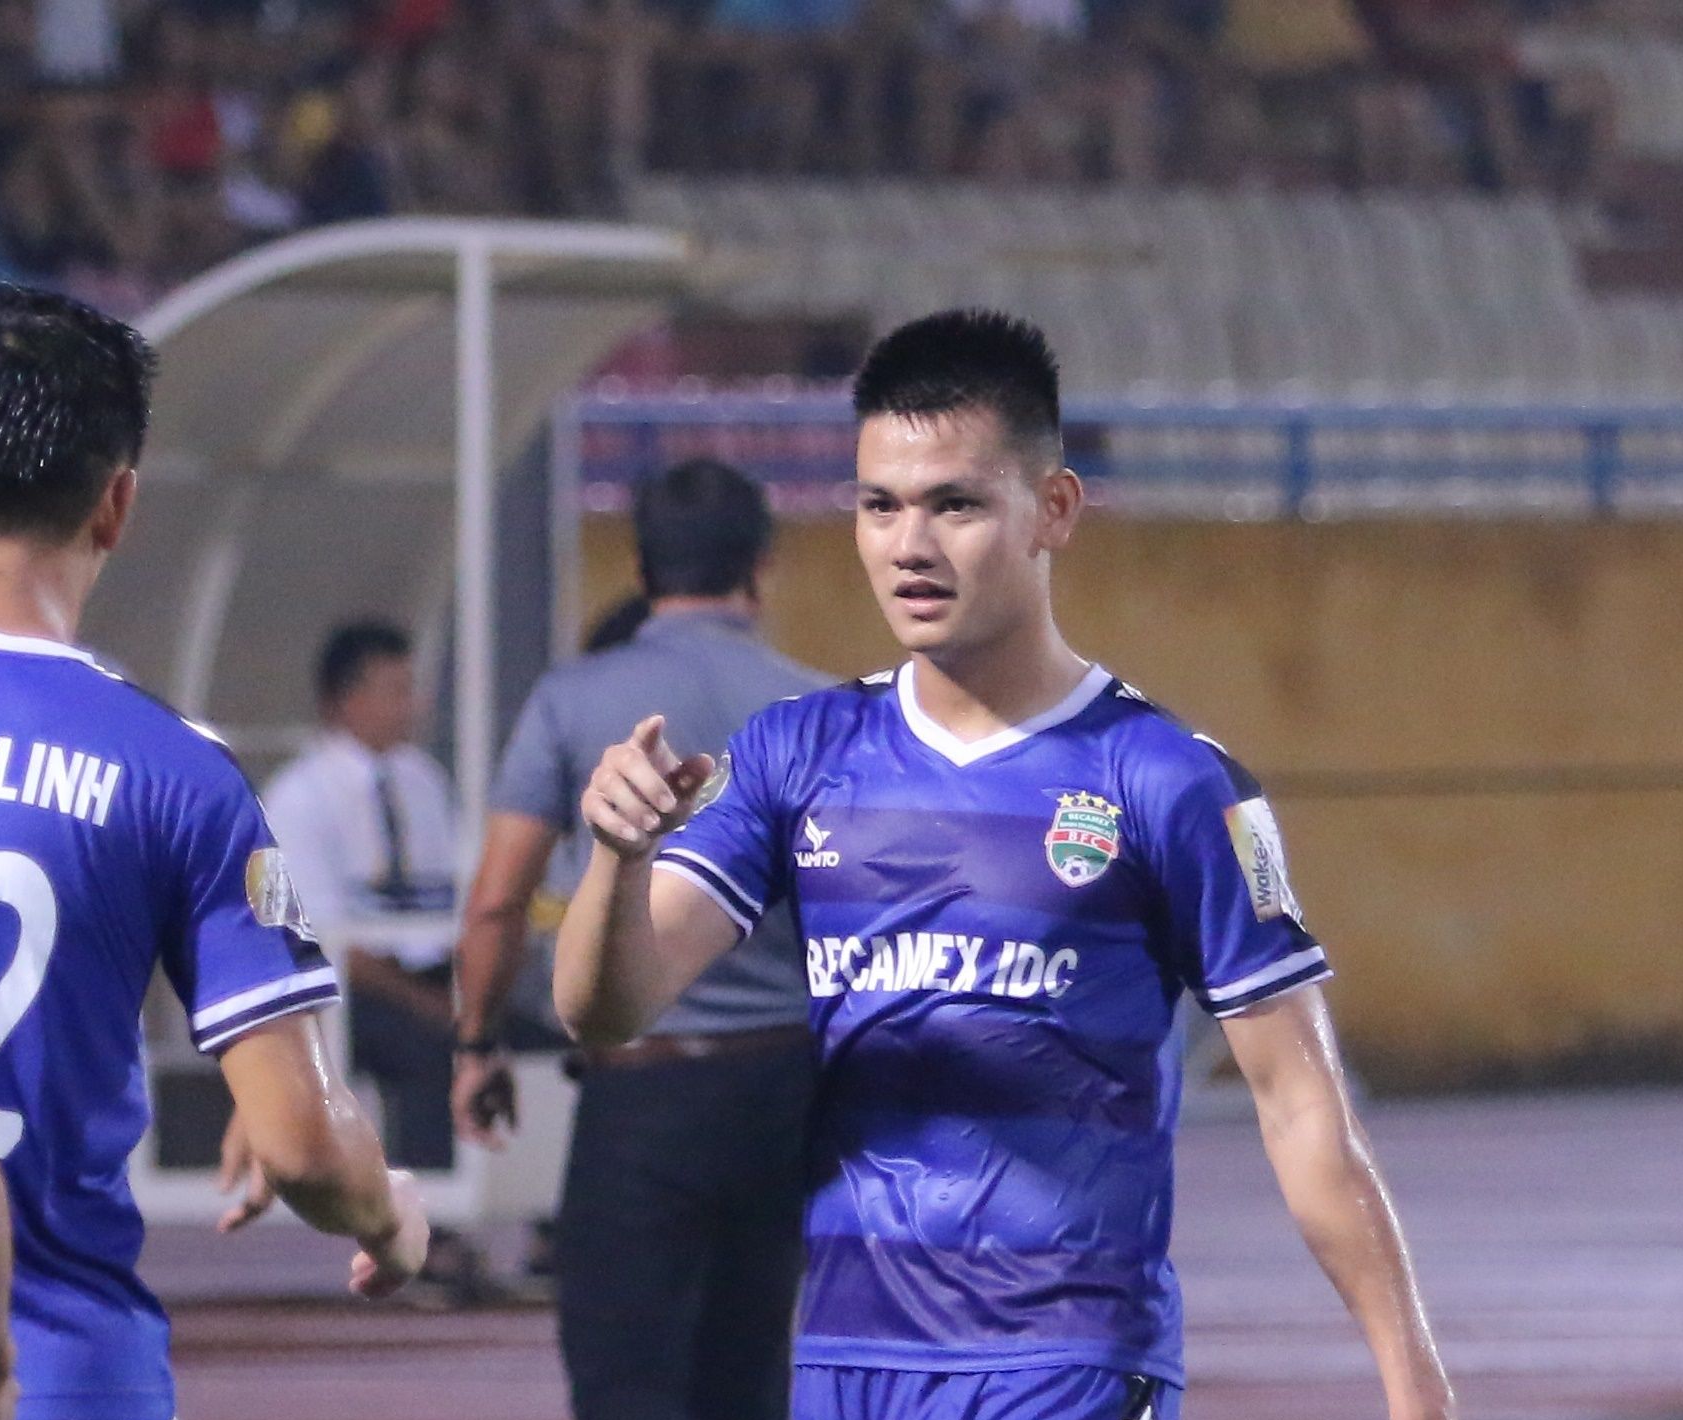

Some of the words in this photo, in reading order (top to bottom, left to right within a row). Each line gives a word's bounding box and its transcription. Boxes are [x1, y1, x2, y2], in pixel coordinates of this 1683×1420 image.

[1068, 831, 1102, 848] BFC
[806, 932, 984, 998] BECAMEX
[990, 941, 1078, 999] IDC
